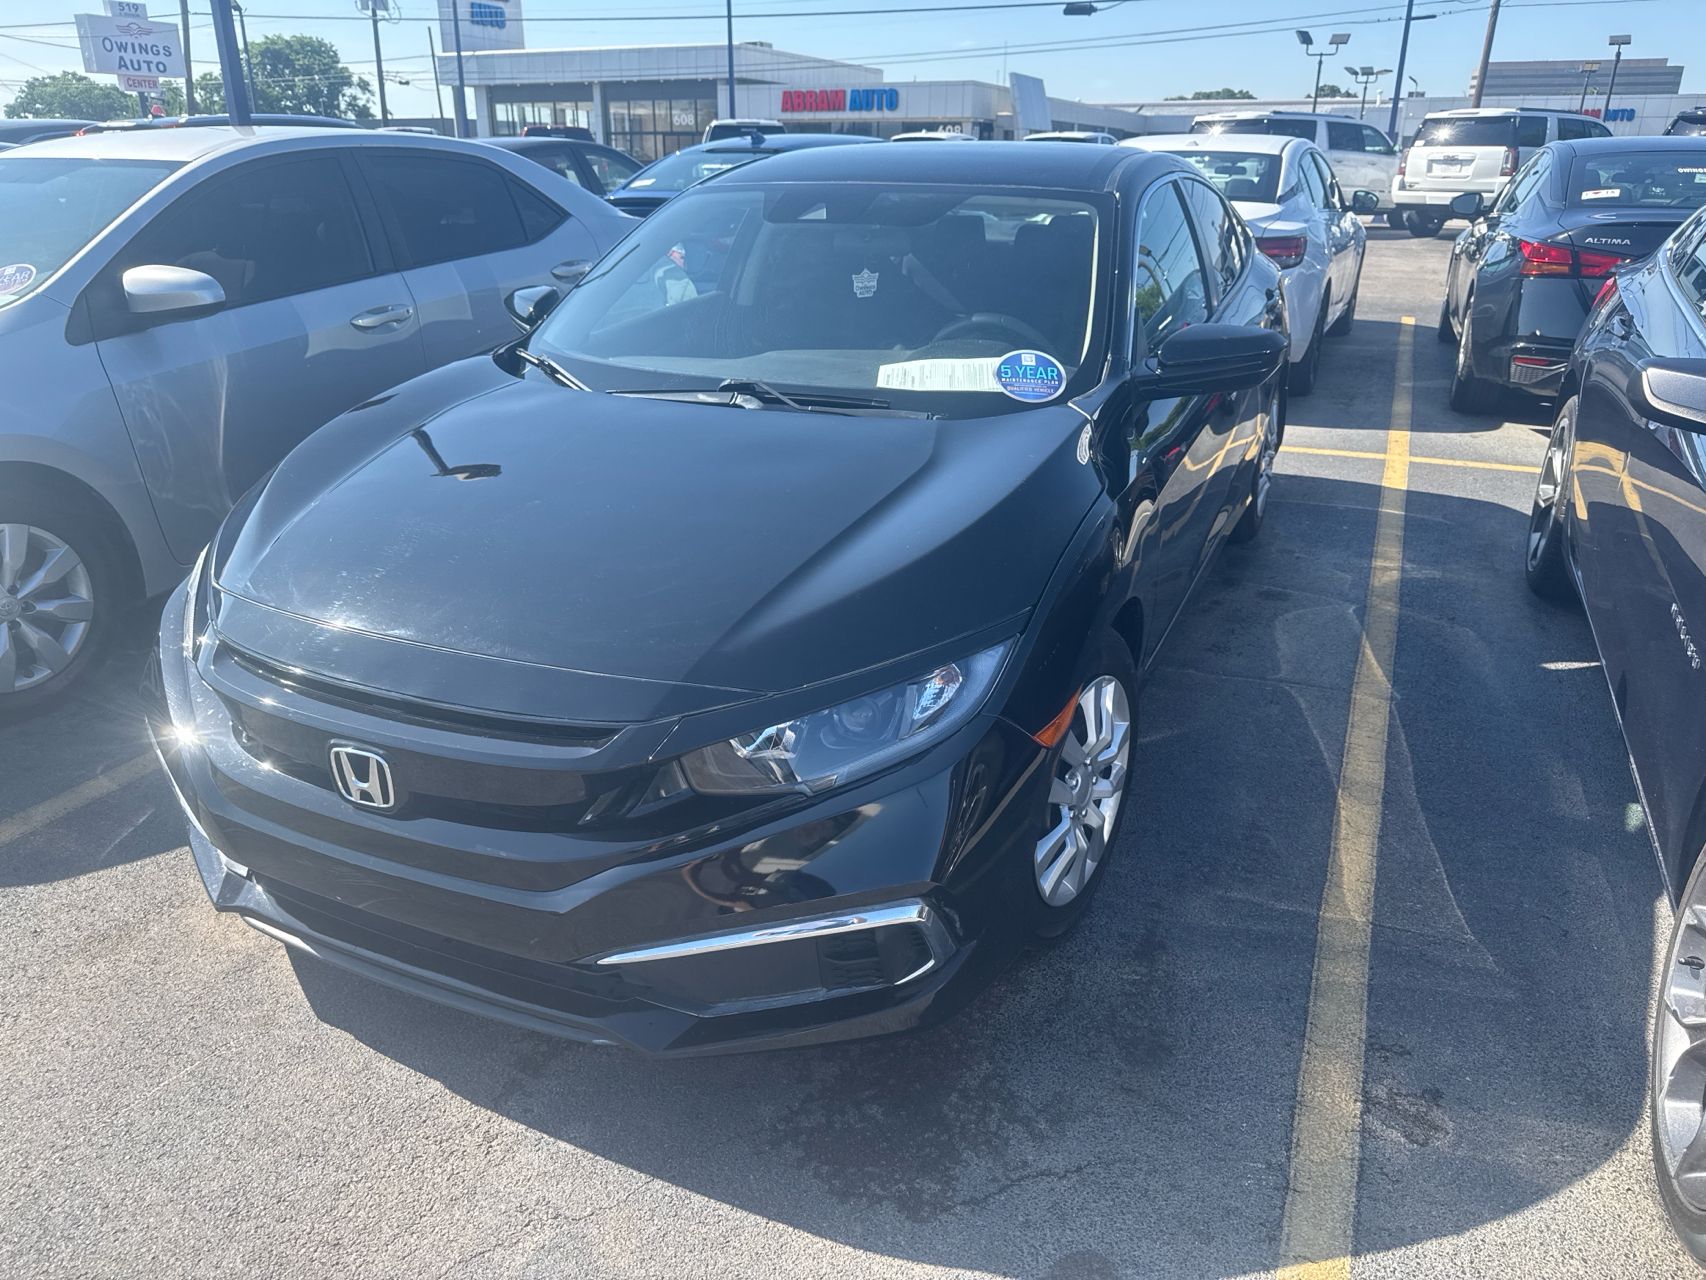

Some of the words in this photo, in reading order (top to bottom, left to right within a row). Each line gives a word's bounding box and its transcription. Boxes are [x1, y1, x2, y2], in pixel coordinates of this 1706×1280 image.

[118, 2, 140, 12] 519
[102, 37, 172, 57] OWINGS
[118, 56, 167, 73] AUTO
[126, 77, 158, 89] CENTER
[781, 90, 846, 113] ABRAM
[849, 88, 898, 112] AUTO
[673, 113, 695, 126] 608
[1584, 237, 1632, 245] ALTIMA
[1000, 364, 1012, 378] 5
[1015, 365, 1059, 380] YEAR
